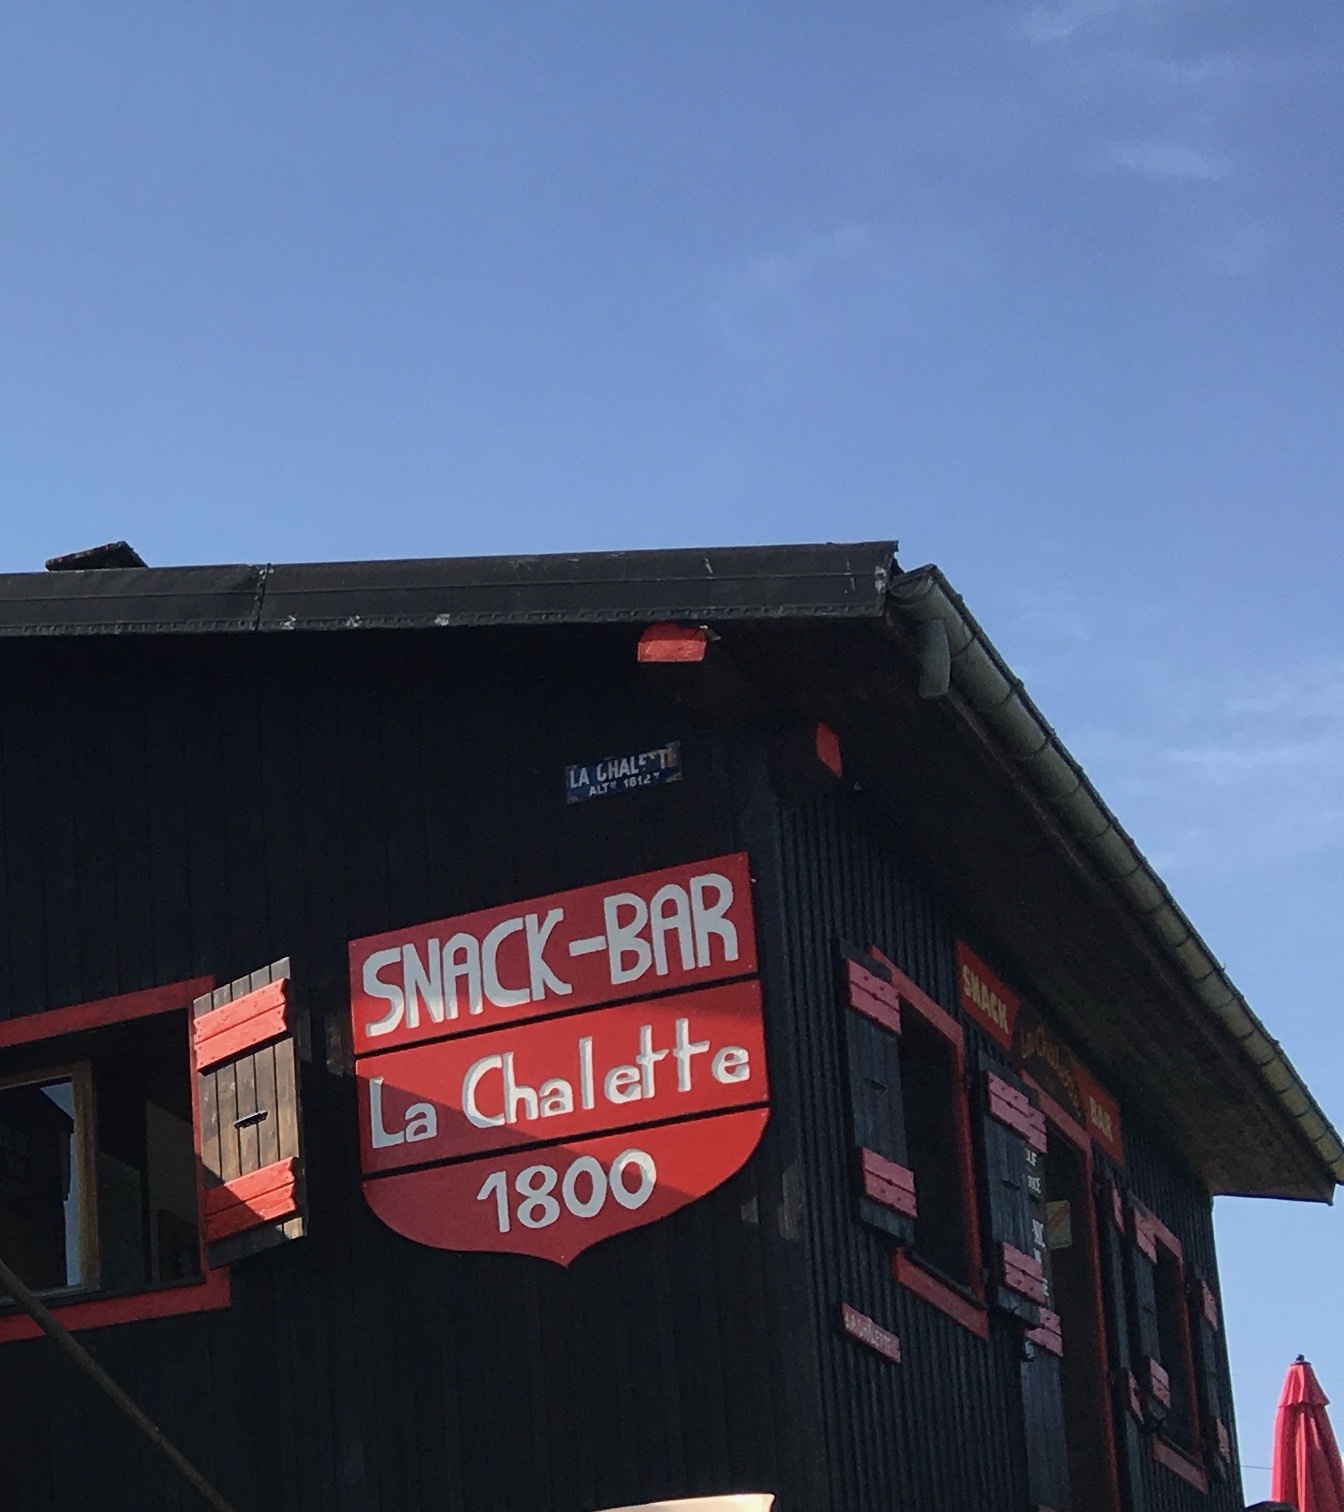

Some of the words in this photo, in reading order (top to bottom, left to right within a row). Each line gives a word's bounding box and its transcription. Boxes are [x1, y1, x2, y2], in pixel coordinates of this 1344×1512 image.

[569, 766, 590, 789] LA
[362, 873, 739, 1037] SNACK-BAR
[962, 963, 1009, 1035] SNACK
[369, 1076, 438, 1149] La
[462, 1017, 750, 1129] Chalette
[476, 1148, 657, 1233] 1800
